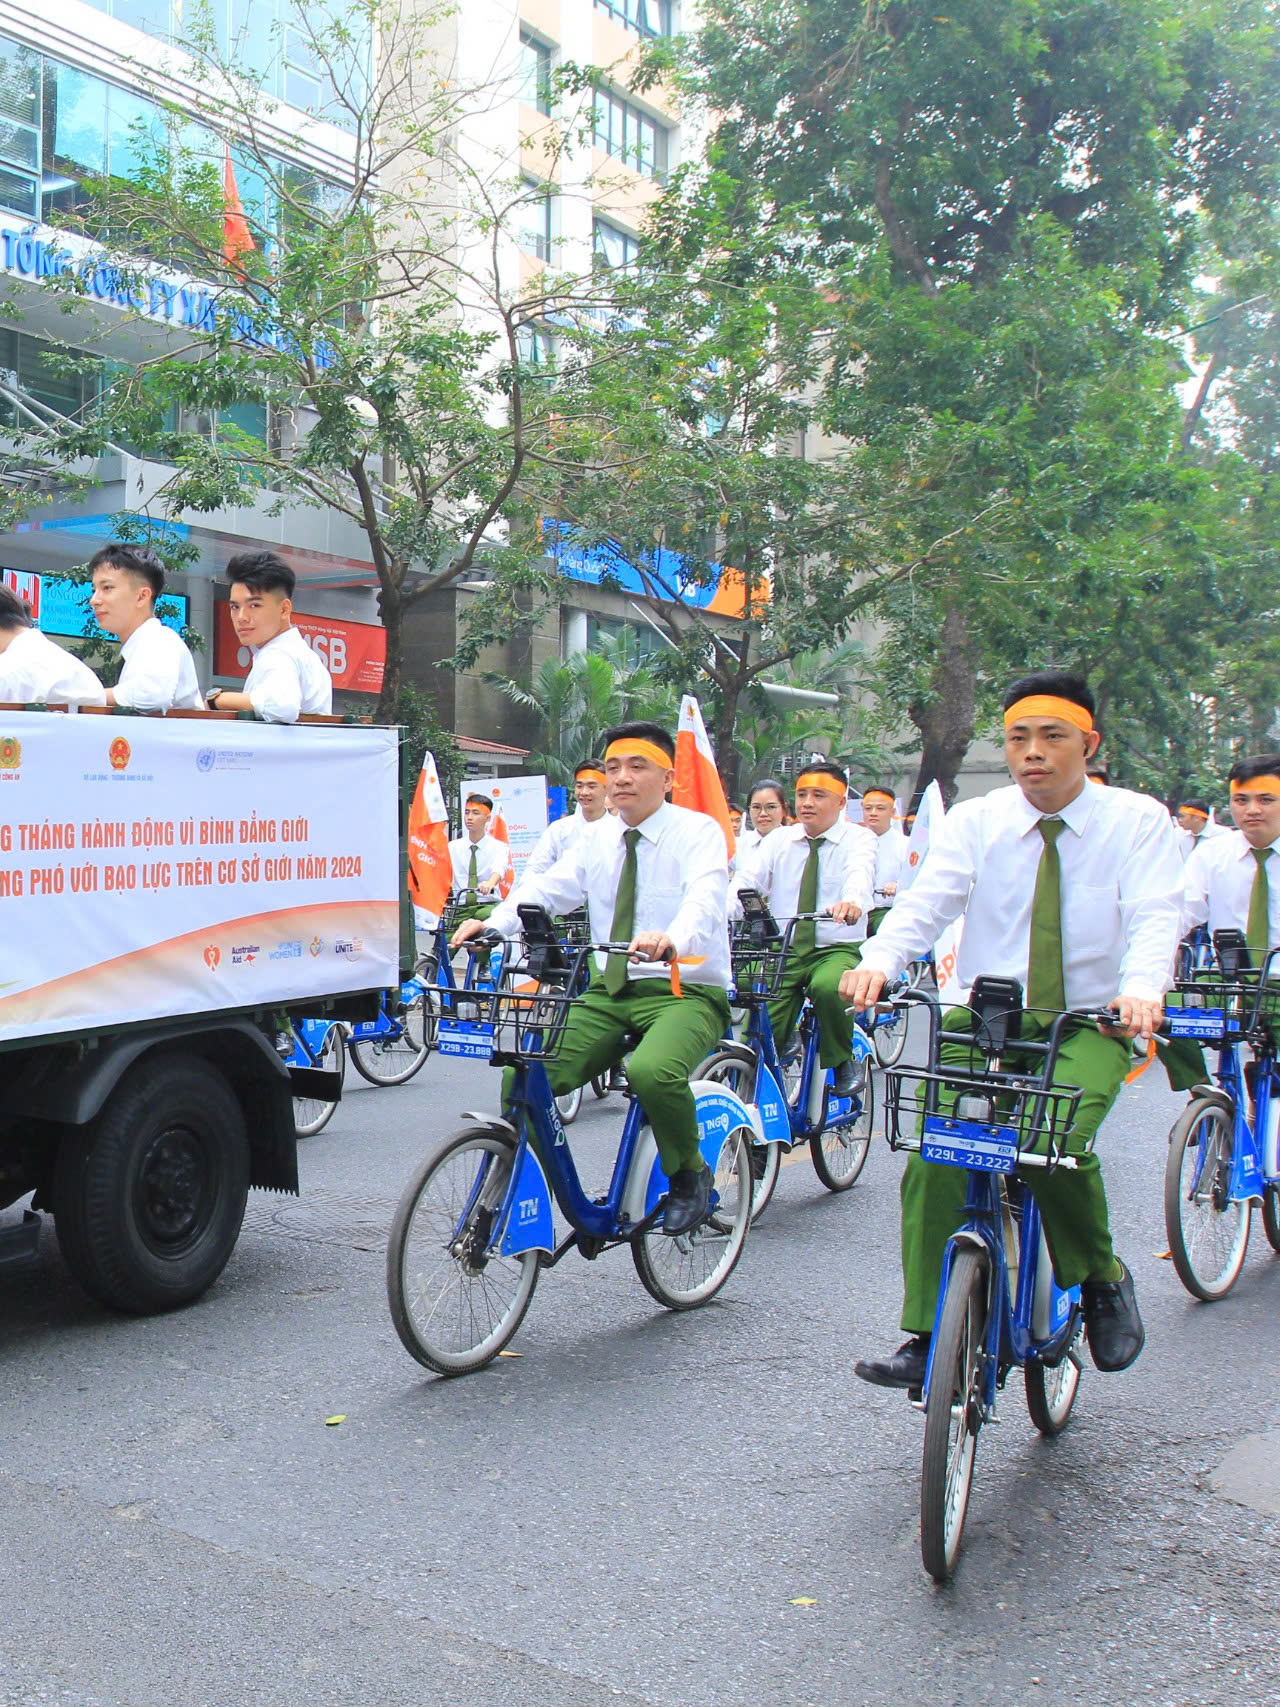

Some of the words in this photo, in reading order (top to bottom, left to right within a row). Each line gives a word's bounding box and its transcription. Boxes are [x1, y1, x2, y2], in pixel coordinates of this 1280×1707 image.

[18, 819, 75, 851] THÁNG
[81, 818, 126, 849] HÀNH
[131, 816, 174, 852] ĐỘNG
[179, 816, 195, 846] VÌ
[199, 816, 234, 845] BÌNH
[239, 810, 276, 845] ĐẲNG
[281, 815, 308, 843] GIỚI
[30, 863, 64, 896] PHÓ
[70, 861, 98, 893] VỚI
[104, 864, 136, 896] BẠO
[142, 862, 171, 894] LỰC
[176, 857, 213, 887] TRÊN
[217, 858, 237, 885] CƠ
[241, 852, 260, 883] SỞ
[264, 854, 292, 882] GIỚI
[297, 853, 327, 880] NĂM
[331, 855, 362, 879] 2024
[232, 944, 260, 955] Australian
[232, 955, 242, 964] Aid
[762, 1103, 779, 1118] TN
[519, 1198, 539, 1220] TN
